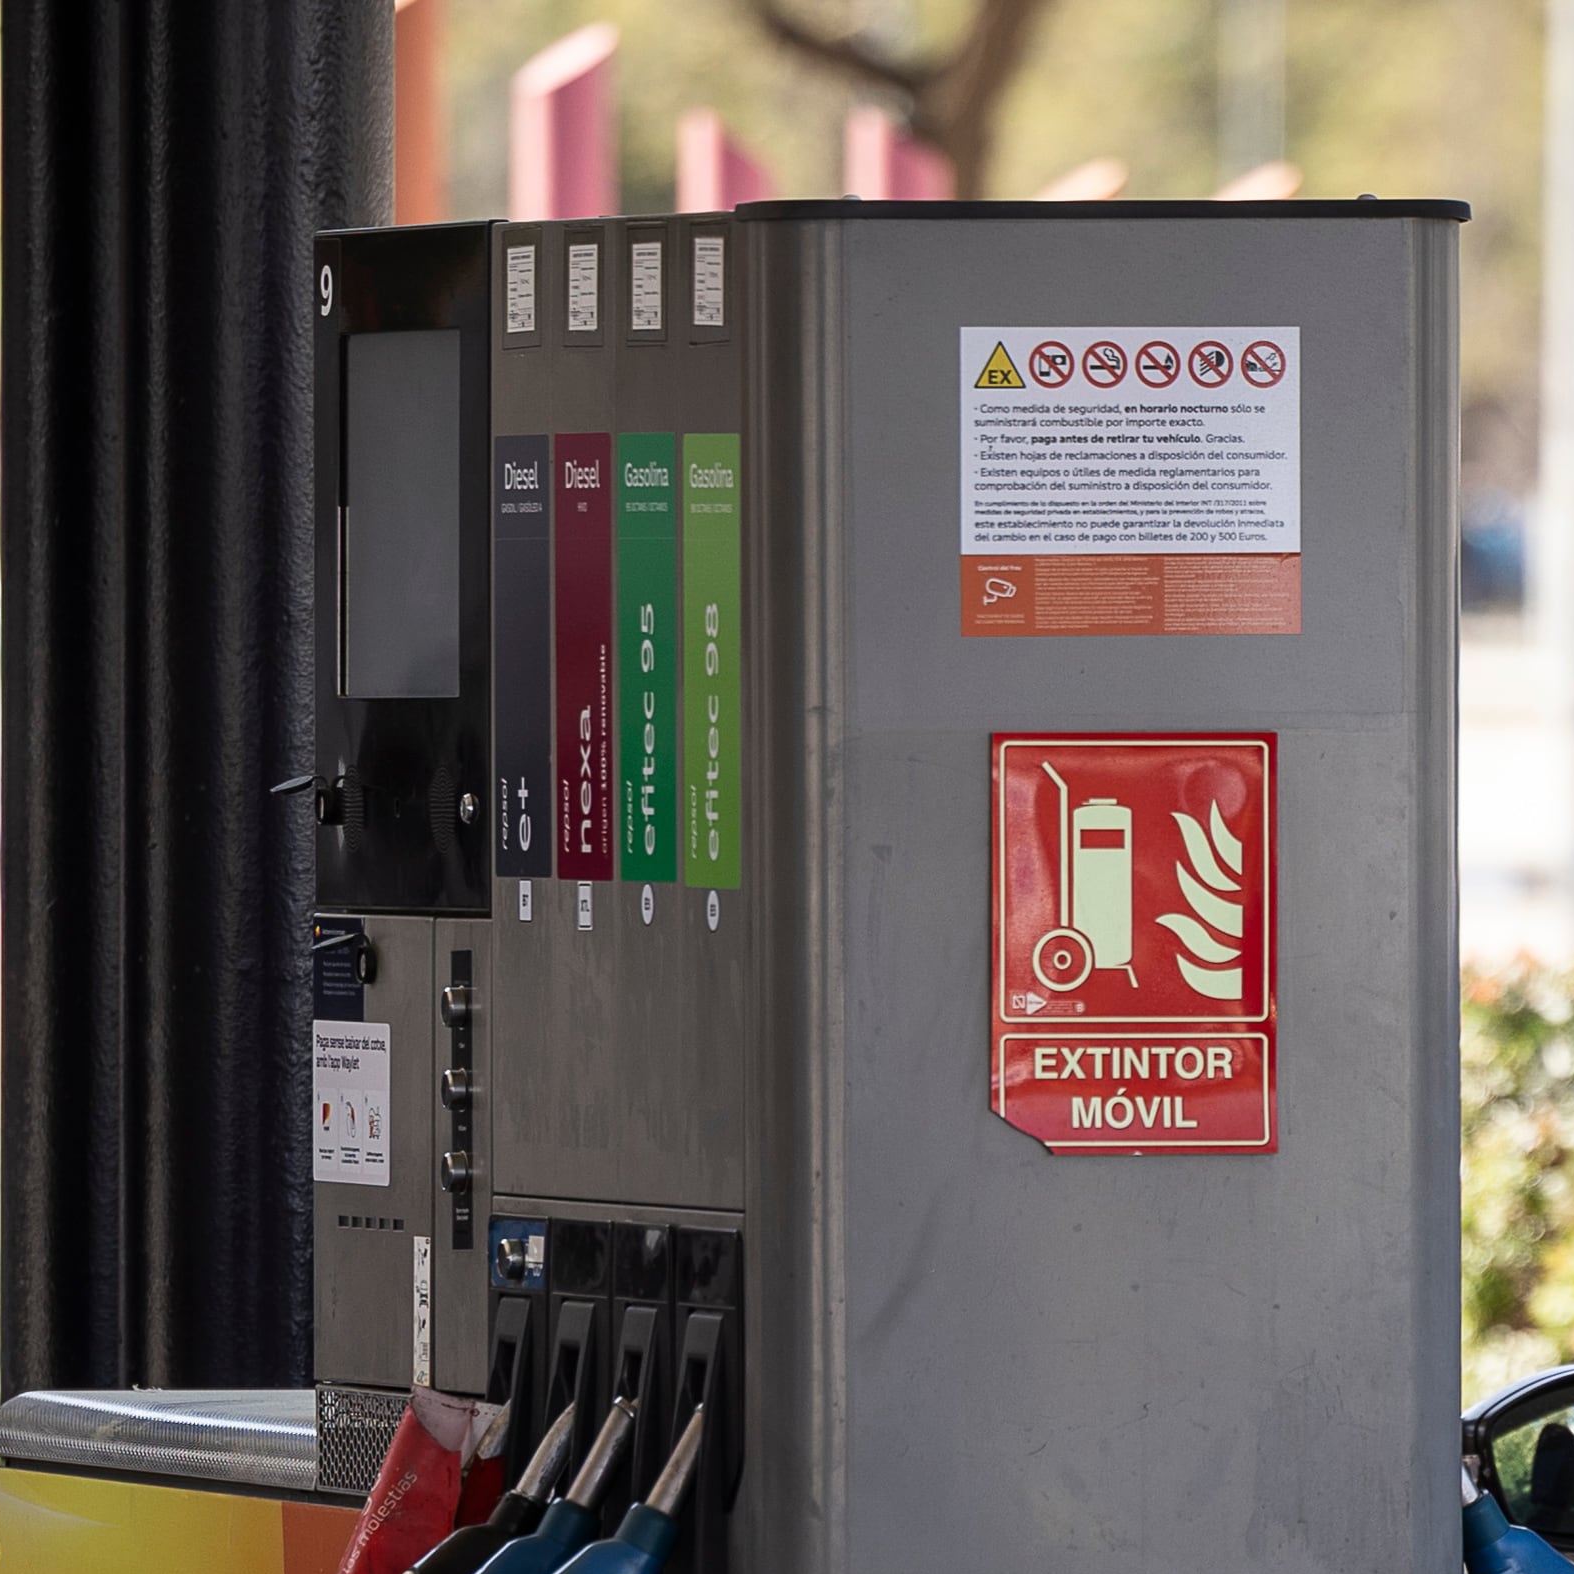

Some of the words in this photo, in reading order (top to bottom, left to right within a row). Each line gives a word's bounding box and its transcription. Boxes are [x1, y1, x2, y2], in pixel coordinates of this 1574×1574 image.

[321, 265, 332, 316] 9
[988, 370, 1012, 385] EX
[974, 417, 1037, 427] suministrará
[1039, 417, 1103, 427] combustible
[1106, 420, 1124, 428] por
[1126, 418, 1167, 428] importe
[1169, 418, 1205, 427] exacto.
[980, 404, 1010, 414] Como
[1012, 404, 1050, 414] medida
[1053, 404, 1066, 413] de
[1068, 404, 1122, 415] seguridad,
[1139, 404, 1178, 413] horario
[1180, 404, 1229, 413] nocturno
[1231, 404, 1252, 413] sólo
[980, 434, 998, 443] Por
[1000, 434, 1029, 445] favor,
[1031, 436, 1057, 446] paga
[1059, 435, 1088, 443] antes
[1090, 434, 1104, 443] de
[1106, 434, 1141, 443] retirar
[1142, 435, 1154, 443] tu
[1156, 434, 1203, 443] vehículo.
[1205, 434, 1245, 443] Gracias.
[980, 451, 1018, 460] Existen
[1019, 451, 1047, 462] hojas
[1049, 451, 1063, 460] de
[1065, 451, 1137, 460] reclamaciones
[1148, 450, 1205, 462] disposición
[1207, 450, 1224, 460] del
[1226, 451, 1287, 460] consumidor.
[504, 461, 539, 490] Diesel
[565, 460, 600, 488] Diesel
[625, 462, 669, 488] Gasolina
[689, 462, 734, 488] Gasolina
[974, 481, 1047, 492] comprobación
[1049, 481, 1066, 490] del
[1068, 481, 1122, 490] suministro
[1133, 481, 1190, 492] disposición
[1192, 481, 1209, 490] del
[1211, 481, 1272, 490] consumidor.
[980, 467, 1018, 477] Existen
[1020, 468, 1061, 479] equipos
[1072, 467, 1101, 477] útiles
[1103, 467, 1116, 477] de
[1118, 467, 1156, 477] medida
[1159, 467, 1235, 479] reglamentarios
[1238, 469, 1260, 478] para
[974, 533, 990, 542] del
[992, 533, 1027, 542] cambio
[1043, 533, 1052, 541] el
[1078, 533, 1090, 541] de
[1092, 534, 1117, 543] pago
[1138, 532, 1173, 541] billetes
[1175, 532, 1187, 541] de
[1190, 532, 1208, 541] 200
[1210, 534, 1216, 543] y
[1219, 532, 1237, 541] 500
[1239, 532, 1267, 541] Euros.
[997, 520, 1073, 528] establecimiento
[1090, 519, 1120, 529] puede
[1122, 520, 1171, 530] garantizar
[1173, 519, 1181, 528] la
[1183, 519, 1236, 528] devolución
[641, 603, 655, 672] 95
[706, 603, 719, 676] 98
[599, 644, 607, 737] renovable
[580, 705, 592, 853] nexa
[641, 692, 655, 855] efitec
[706, 695, 719, 861] efitec
[518, 777, 531, 851] e+
[563, 780, 571, 853] repsol
[600, 797, 608, 854] origen
[626, 781, 634, 854] repsol
[690, 785, 698, 859] repsol
[1033, 1047, 1233, 1080] EXTINTOR
[1071, 1088, 1198, 1130] MÓVIL
[358, 1470, 419, 1547] molestias
